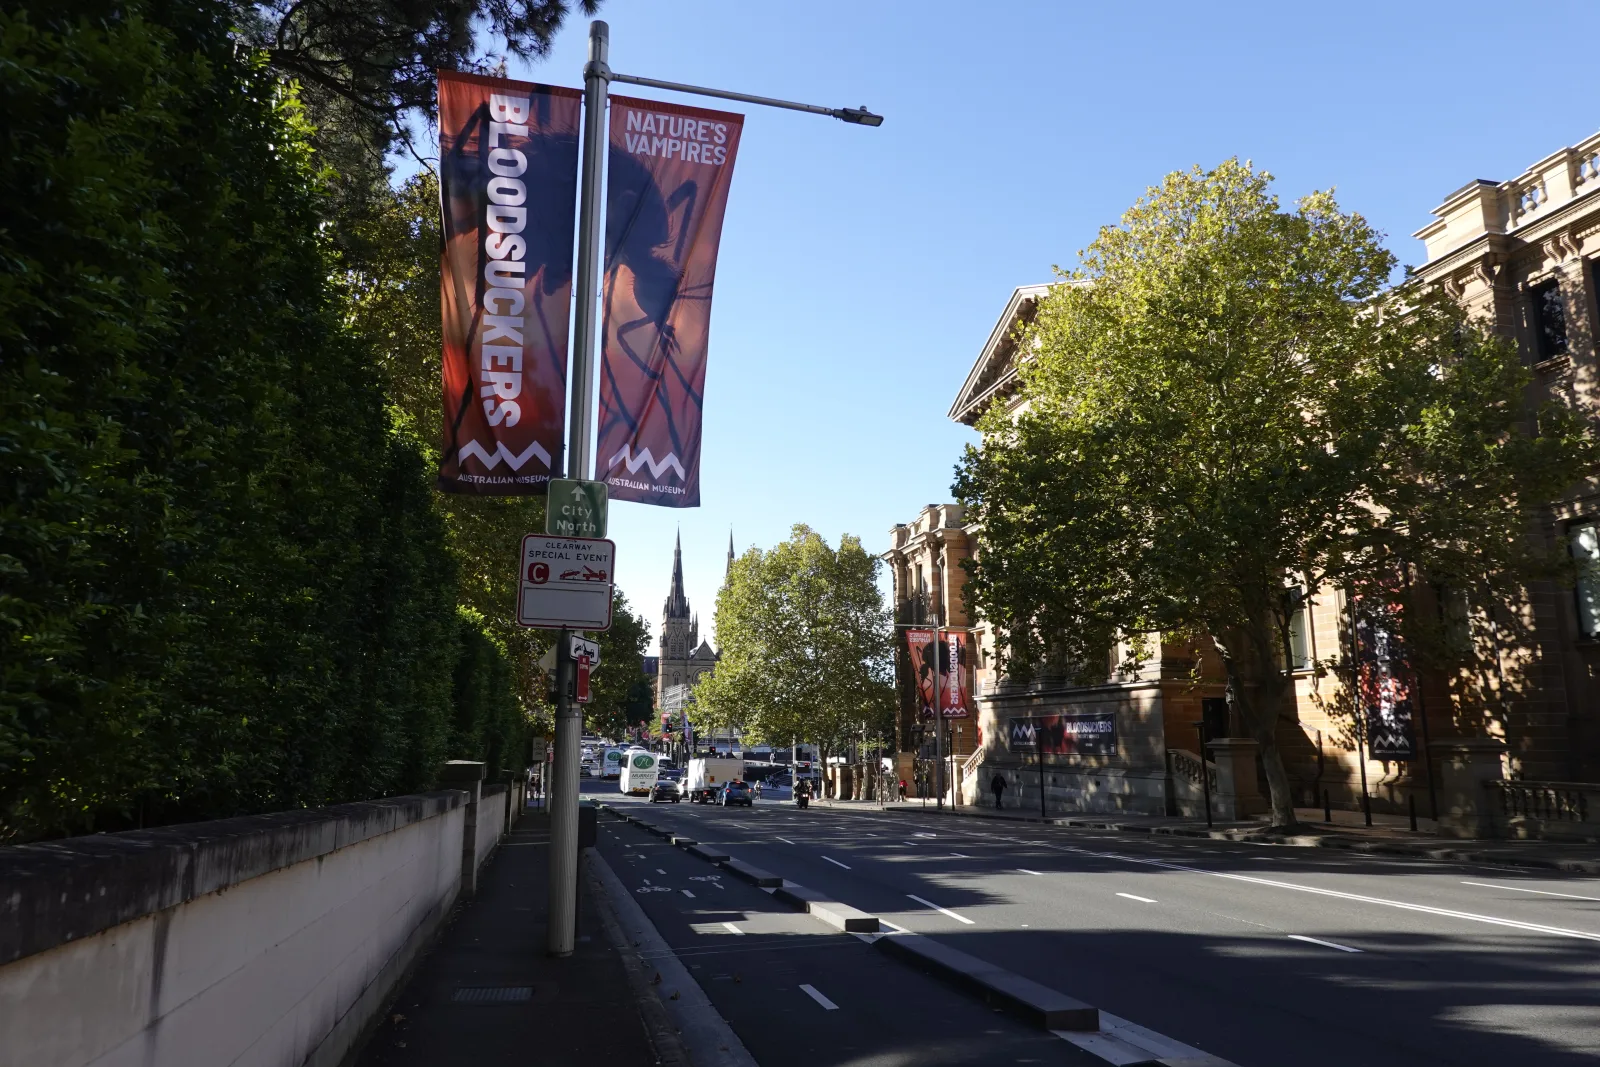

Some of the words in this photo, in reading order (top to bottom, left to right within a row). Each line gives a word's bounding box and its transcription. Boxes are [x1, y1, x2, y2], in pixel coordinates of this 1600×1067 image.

[626, 110, 727, 144] NATURE'S
[625, 132, 726, 166] VAMPIRES
[482, 93, 530, 428] BLOODSUCKERS
[457, 473, 514, 484] AUSTRALIAN
[608, 477, 650, 490] AUSTRALIAN
[652, 484, 686, 495] MUSEUM
[561, 505, 593, 519] City
[556, 519, 597, 532] North
[545, 541, 593, 551] CLEARWAY
[528, 550, 571, 560] SPECIAL
[576, 553, 609, 562] EVENT
[532, 564, 545, 583] C
[1066, 721, 1112, 733] BLOODSUCKERS
